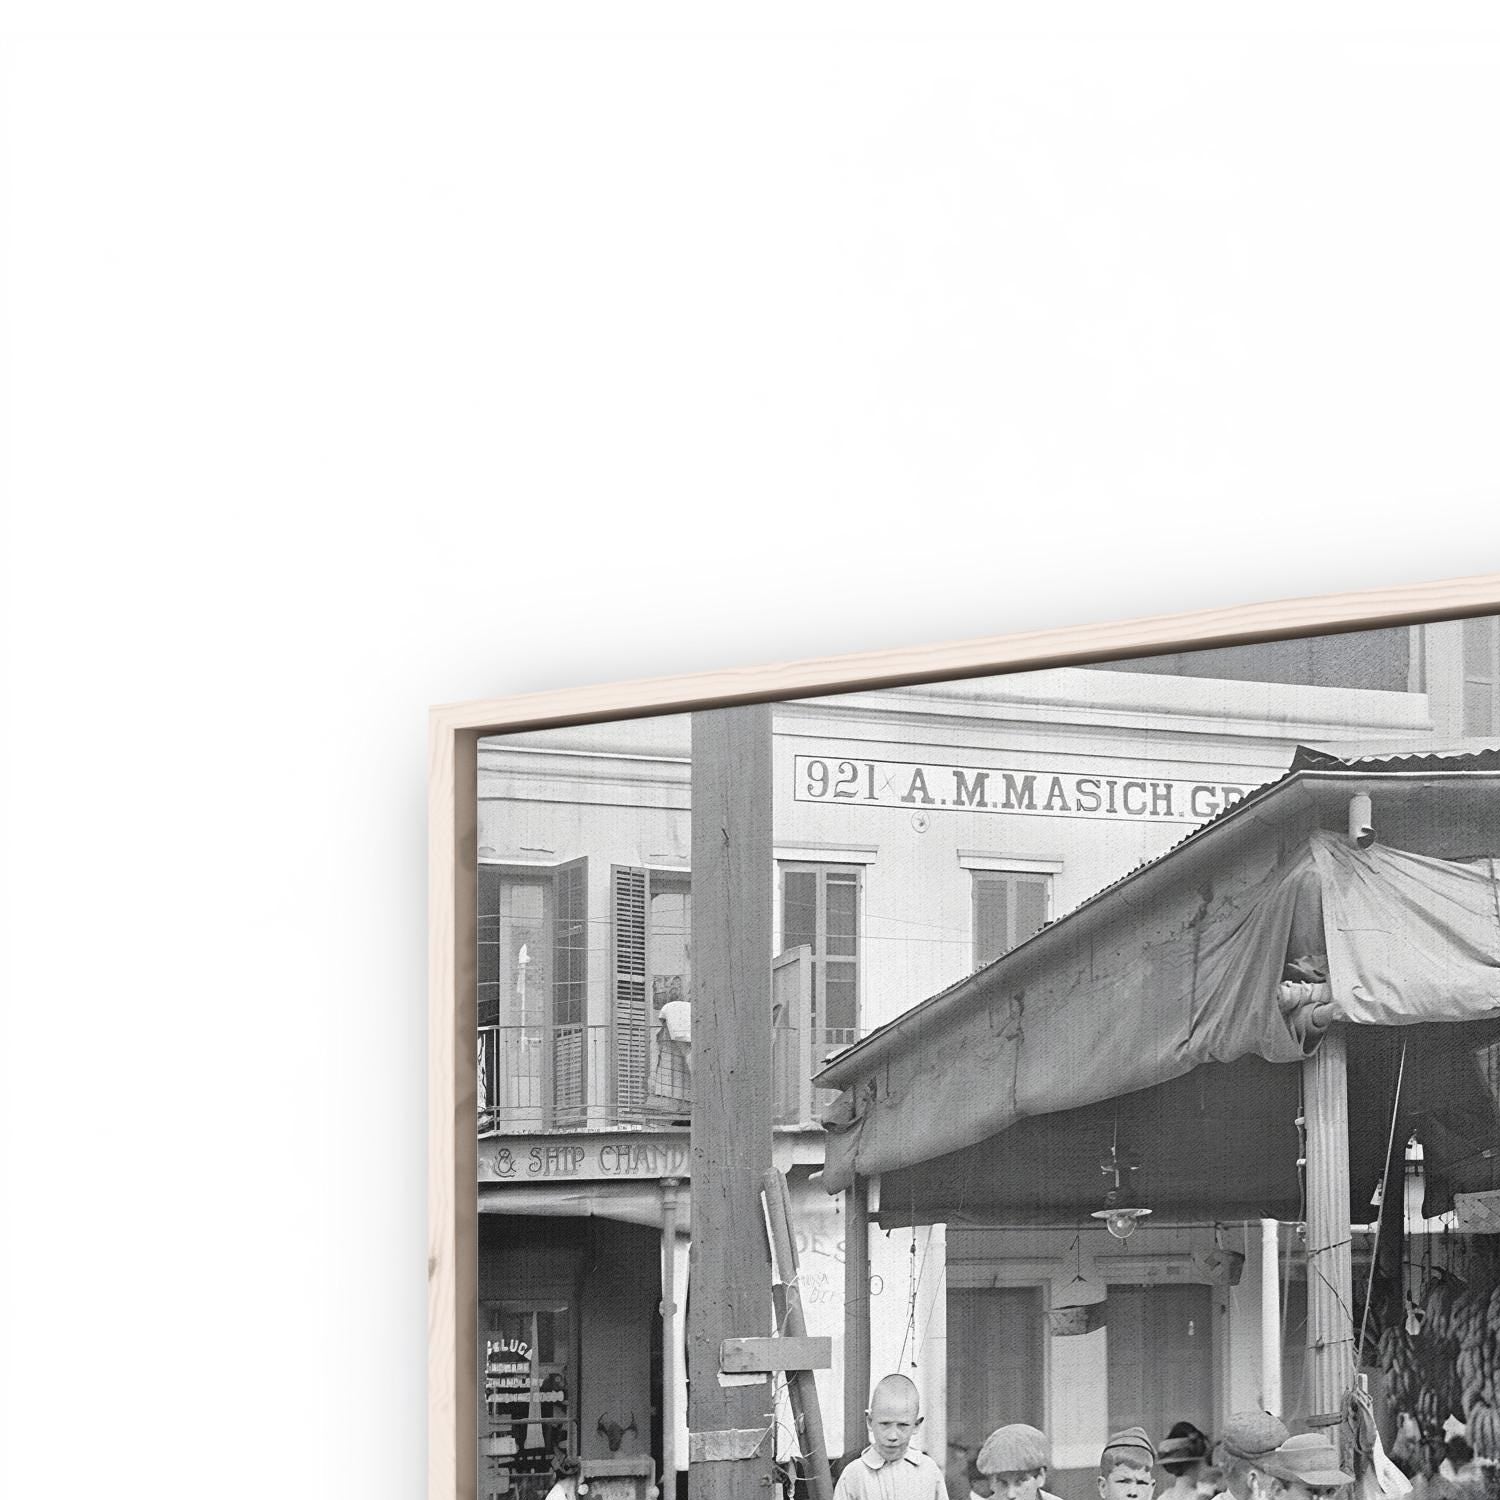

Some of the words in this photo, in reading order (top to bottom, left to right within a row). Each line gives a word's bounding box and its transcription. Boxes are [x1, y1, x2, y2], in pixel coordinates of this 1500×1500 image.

[806, 759, 880, 801] 921
[493, 1148, 517, 1178] &
[527, 1146, 586, 1177] SHIP
